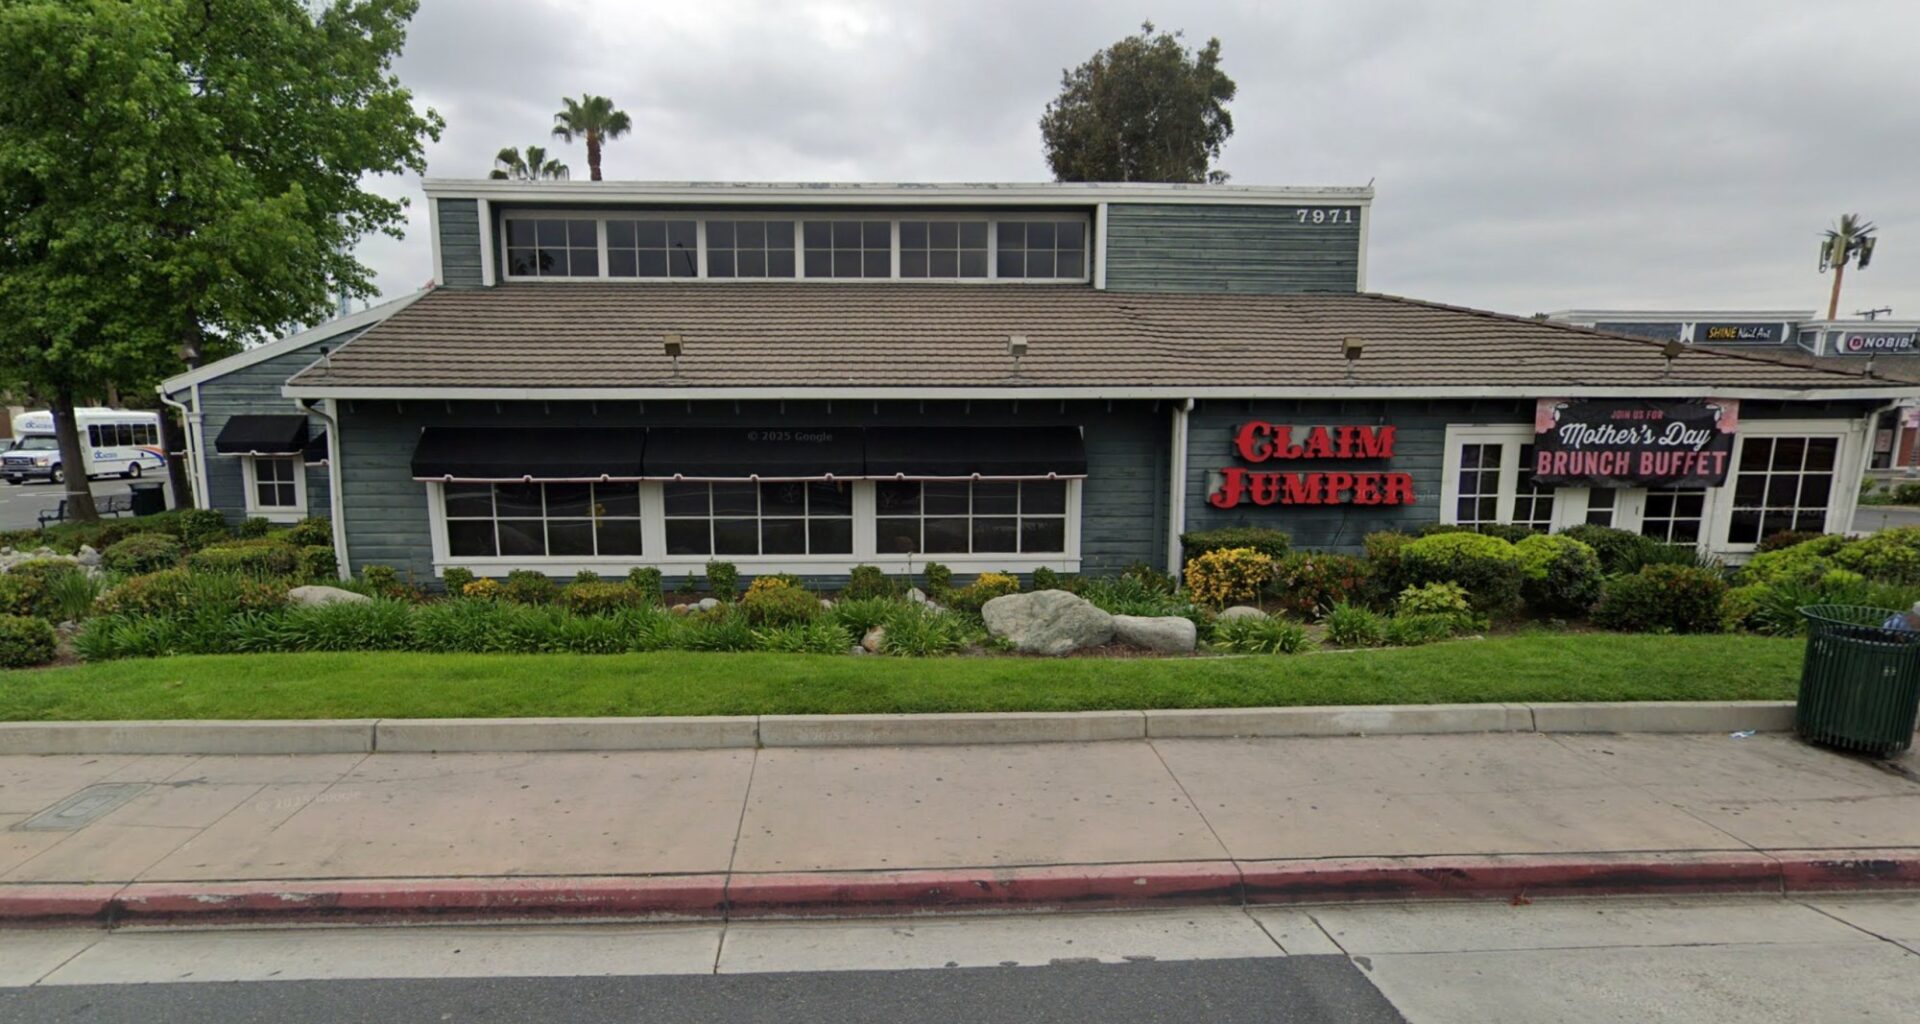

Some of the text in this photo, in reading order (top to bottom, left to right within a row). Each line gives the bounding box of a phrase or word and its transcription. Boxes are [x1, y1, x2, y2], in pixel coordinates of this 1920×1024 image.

[1296, 209, 1352, 223] 7971
[1708, 326, 1738, 338] SHINE
[1611, 409, 1664, 420] JOIN US FOR
[1234, 421, 1397, 462] CLAIM
[1559, 421, 1711, 451] Mother's Day
[1536, 451, 1727, 475] BRUNCH BUFFET
[1209, 467, 1416, 509] JUMPER
